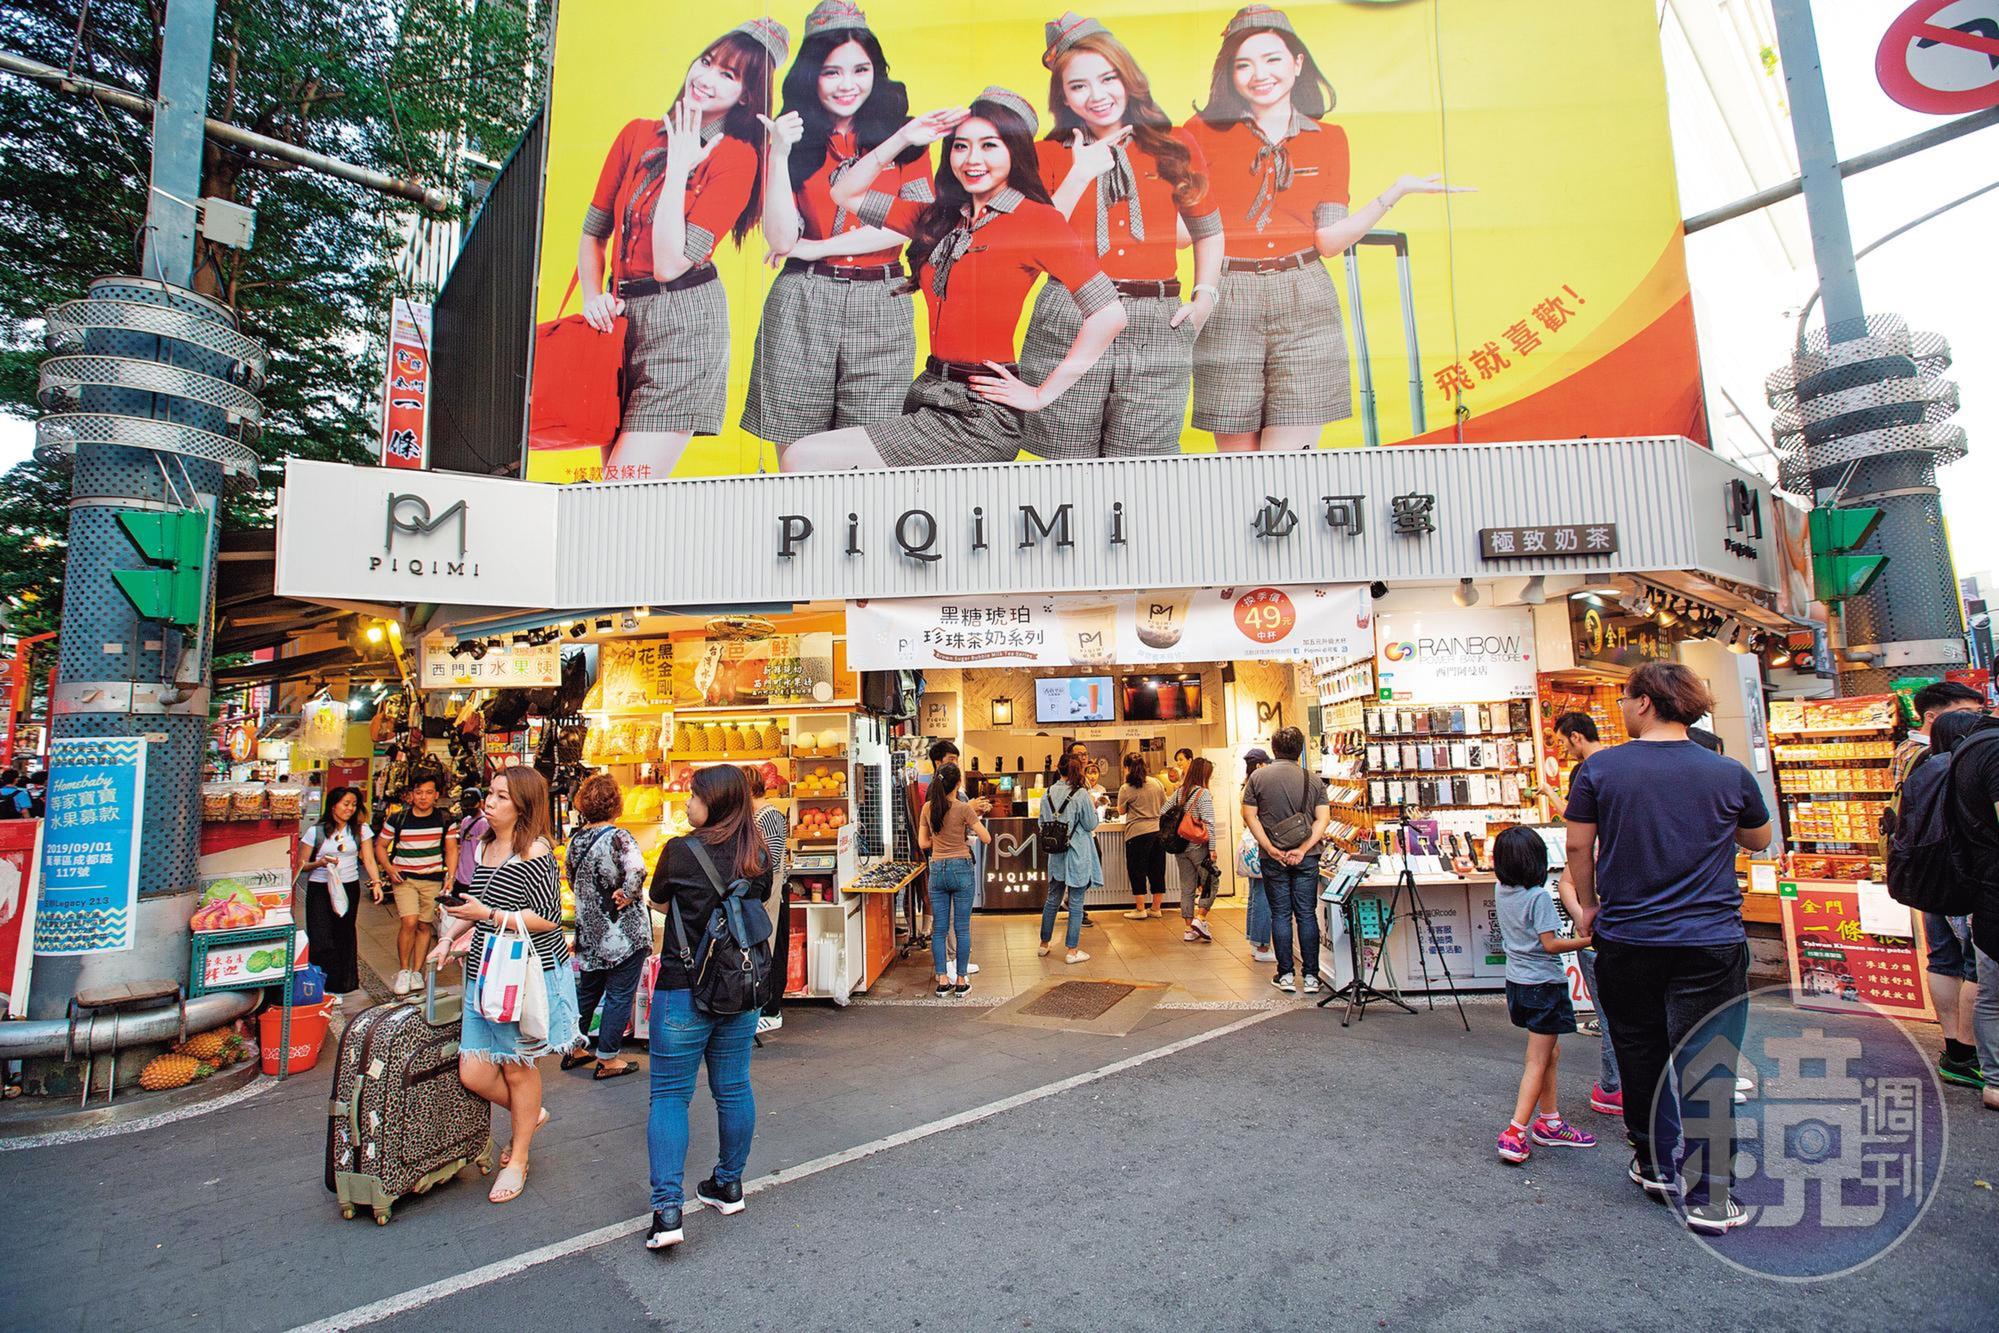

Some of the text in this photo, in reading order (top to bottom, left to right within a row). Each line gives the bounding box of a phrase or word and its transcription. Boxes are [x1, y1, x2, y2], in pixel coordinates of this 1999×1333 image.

[1434, 284, 1586, 402] 飛就喜歡!
[1252, 490, 1438, 539] 必可蜜
[1490, 526, 1612, 554] 極致奶茶
[940, 605, 1031, 627] 黑糖琥珀
[1244, 605, 1281, 629] 49
[924, 627, 1044, 650] 珍珠茶奶系列
[1257, 630, 1277, 640] 中杯
[1419, 636, 1520, 657] RAINBOW
[432, 660, 553, 677] 西門町水果姨
[638, 647, 655, 684] 花生
[1460, 655, 1485, 664] BANK
[1490, 653, 1521, 662] STORE
[656, 643, 674, 696] 黑金剛
[53, 772, 114, 793] Homebaby
[50, 805, 120, 831] 水果募款
[46, 842, 113, 855] 2019/09/01
[55, 866, 91, 878] 117號
[89, 896, 110, 906] 213
[1799, 898, 1845, 916] 金門
[1802, 940, 1833, 949] Taiwan
